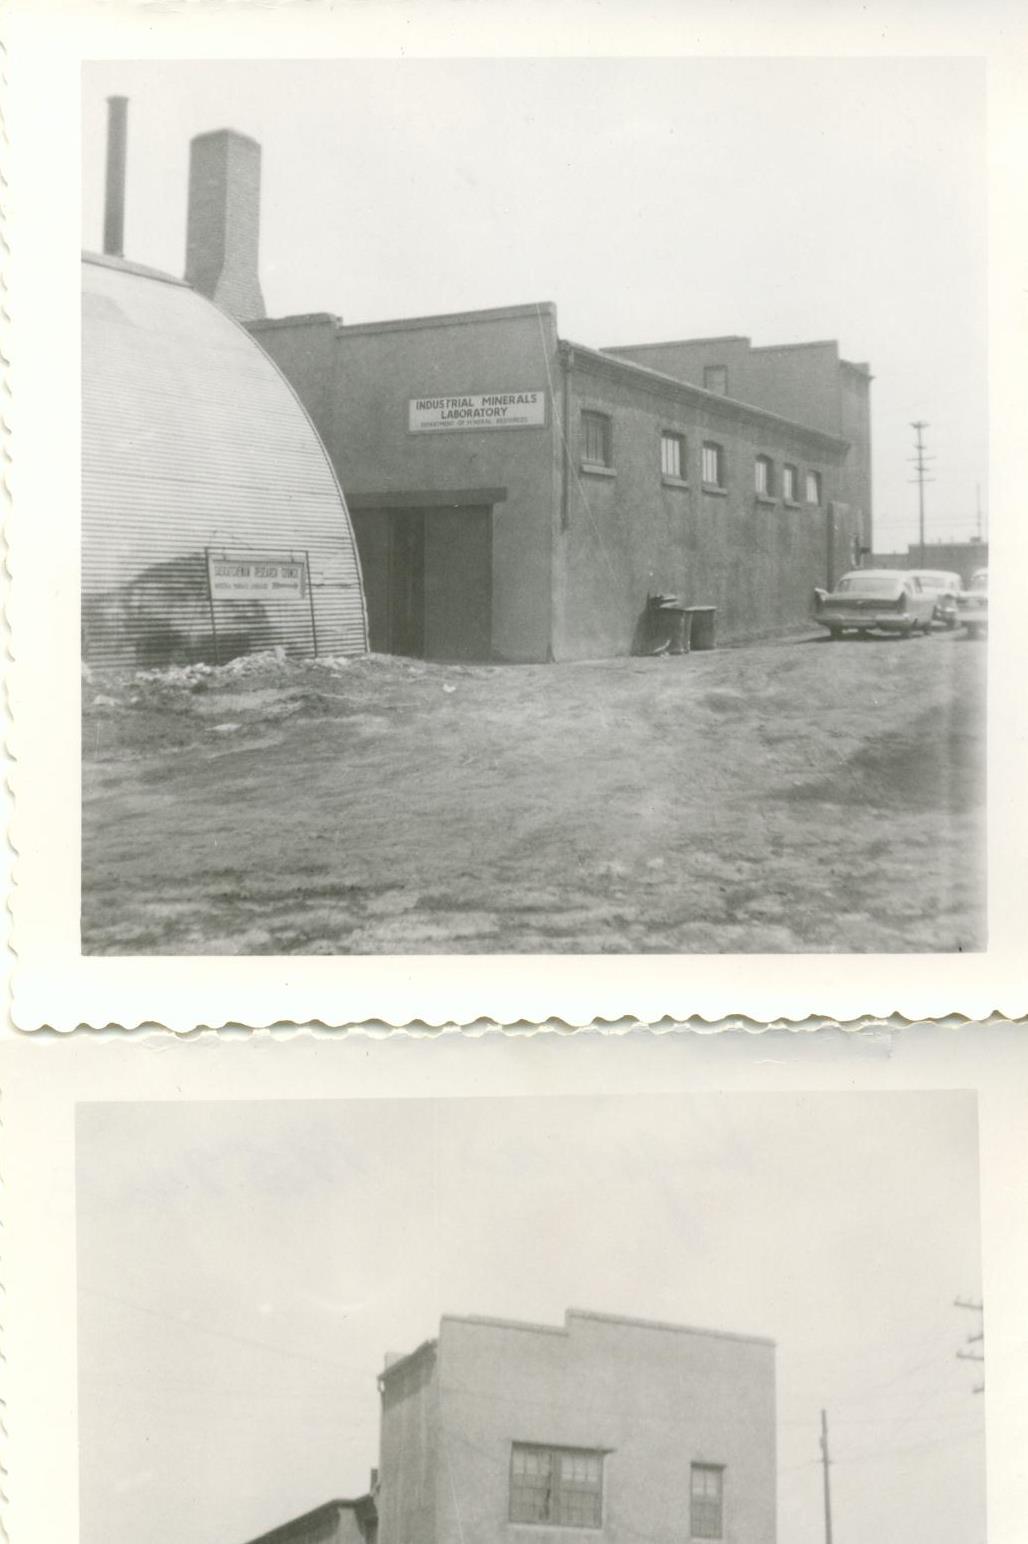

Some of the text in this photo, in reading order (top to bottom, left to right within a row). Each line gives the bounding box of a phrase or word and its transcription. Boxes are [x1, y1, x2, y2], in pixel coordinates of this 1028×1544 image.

[416, 394, 537, 410] INDUSTRIAL MINERALS
[441, 407, 508, 419] LABORATORY
